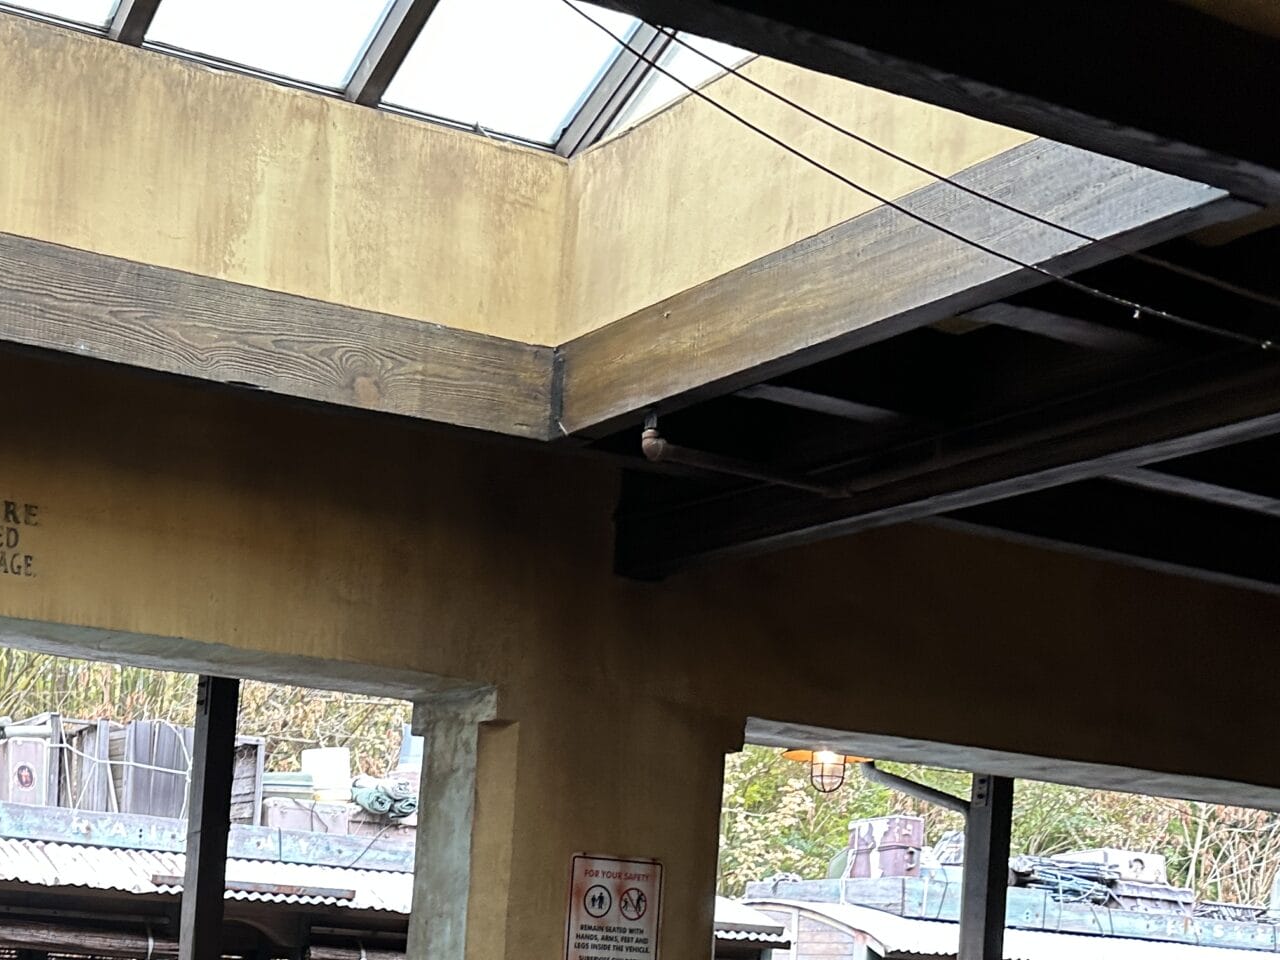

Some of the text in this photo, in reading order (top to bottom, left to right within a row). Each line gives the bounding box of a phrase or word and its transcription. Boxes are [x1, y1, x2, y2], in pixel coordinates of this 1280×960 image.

[584, 869, 650, 881] FOR YOUR SAFETY
[580, 924, 604, 932] REMAIN
[605, 926, 627, 934] SEATED
[575, 933, 599, 942] HANDS,
[600, 935, 619, 943] ARMS,
[574, 942, 590, 950] LEGS
[590, 943, 611, 951] INSIDE
[612, 944, 624, 952] THE
